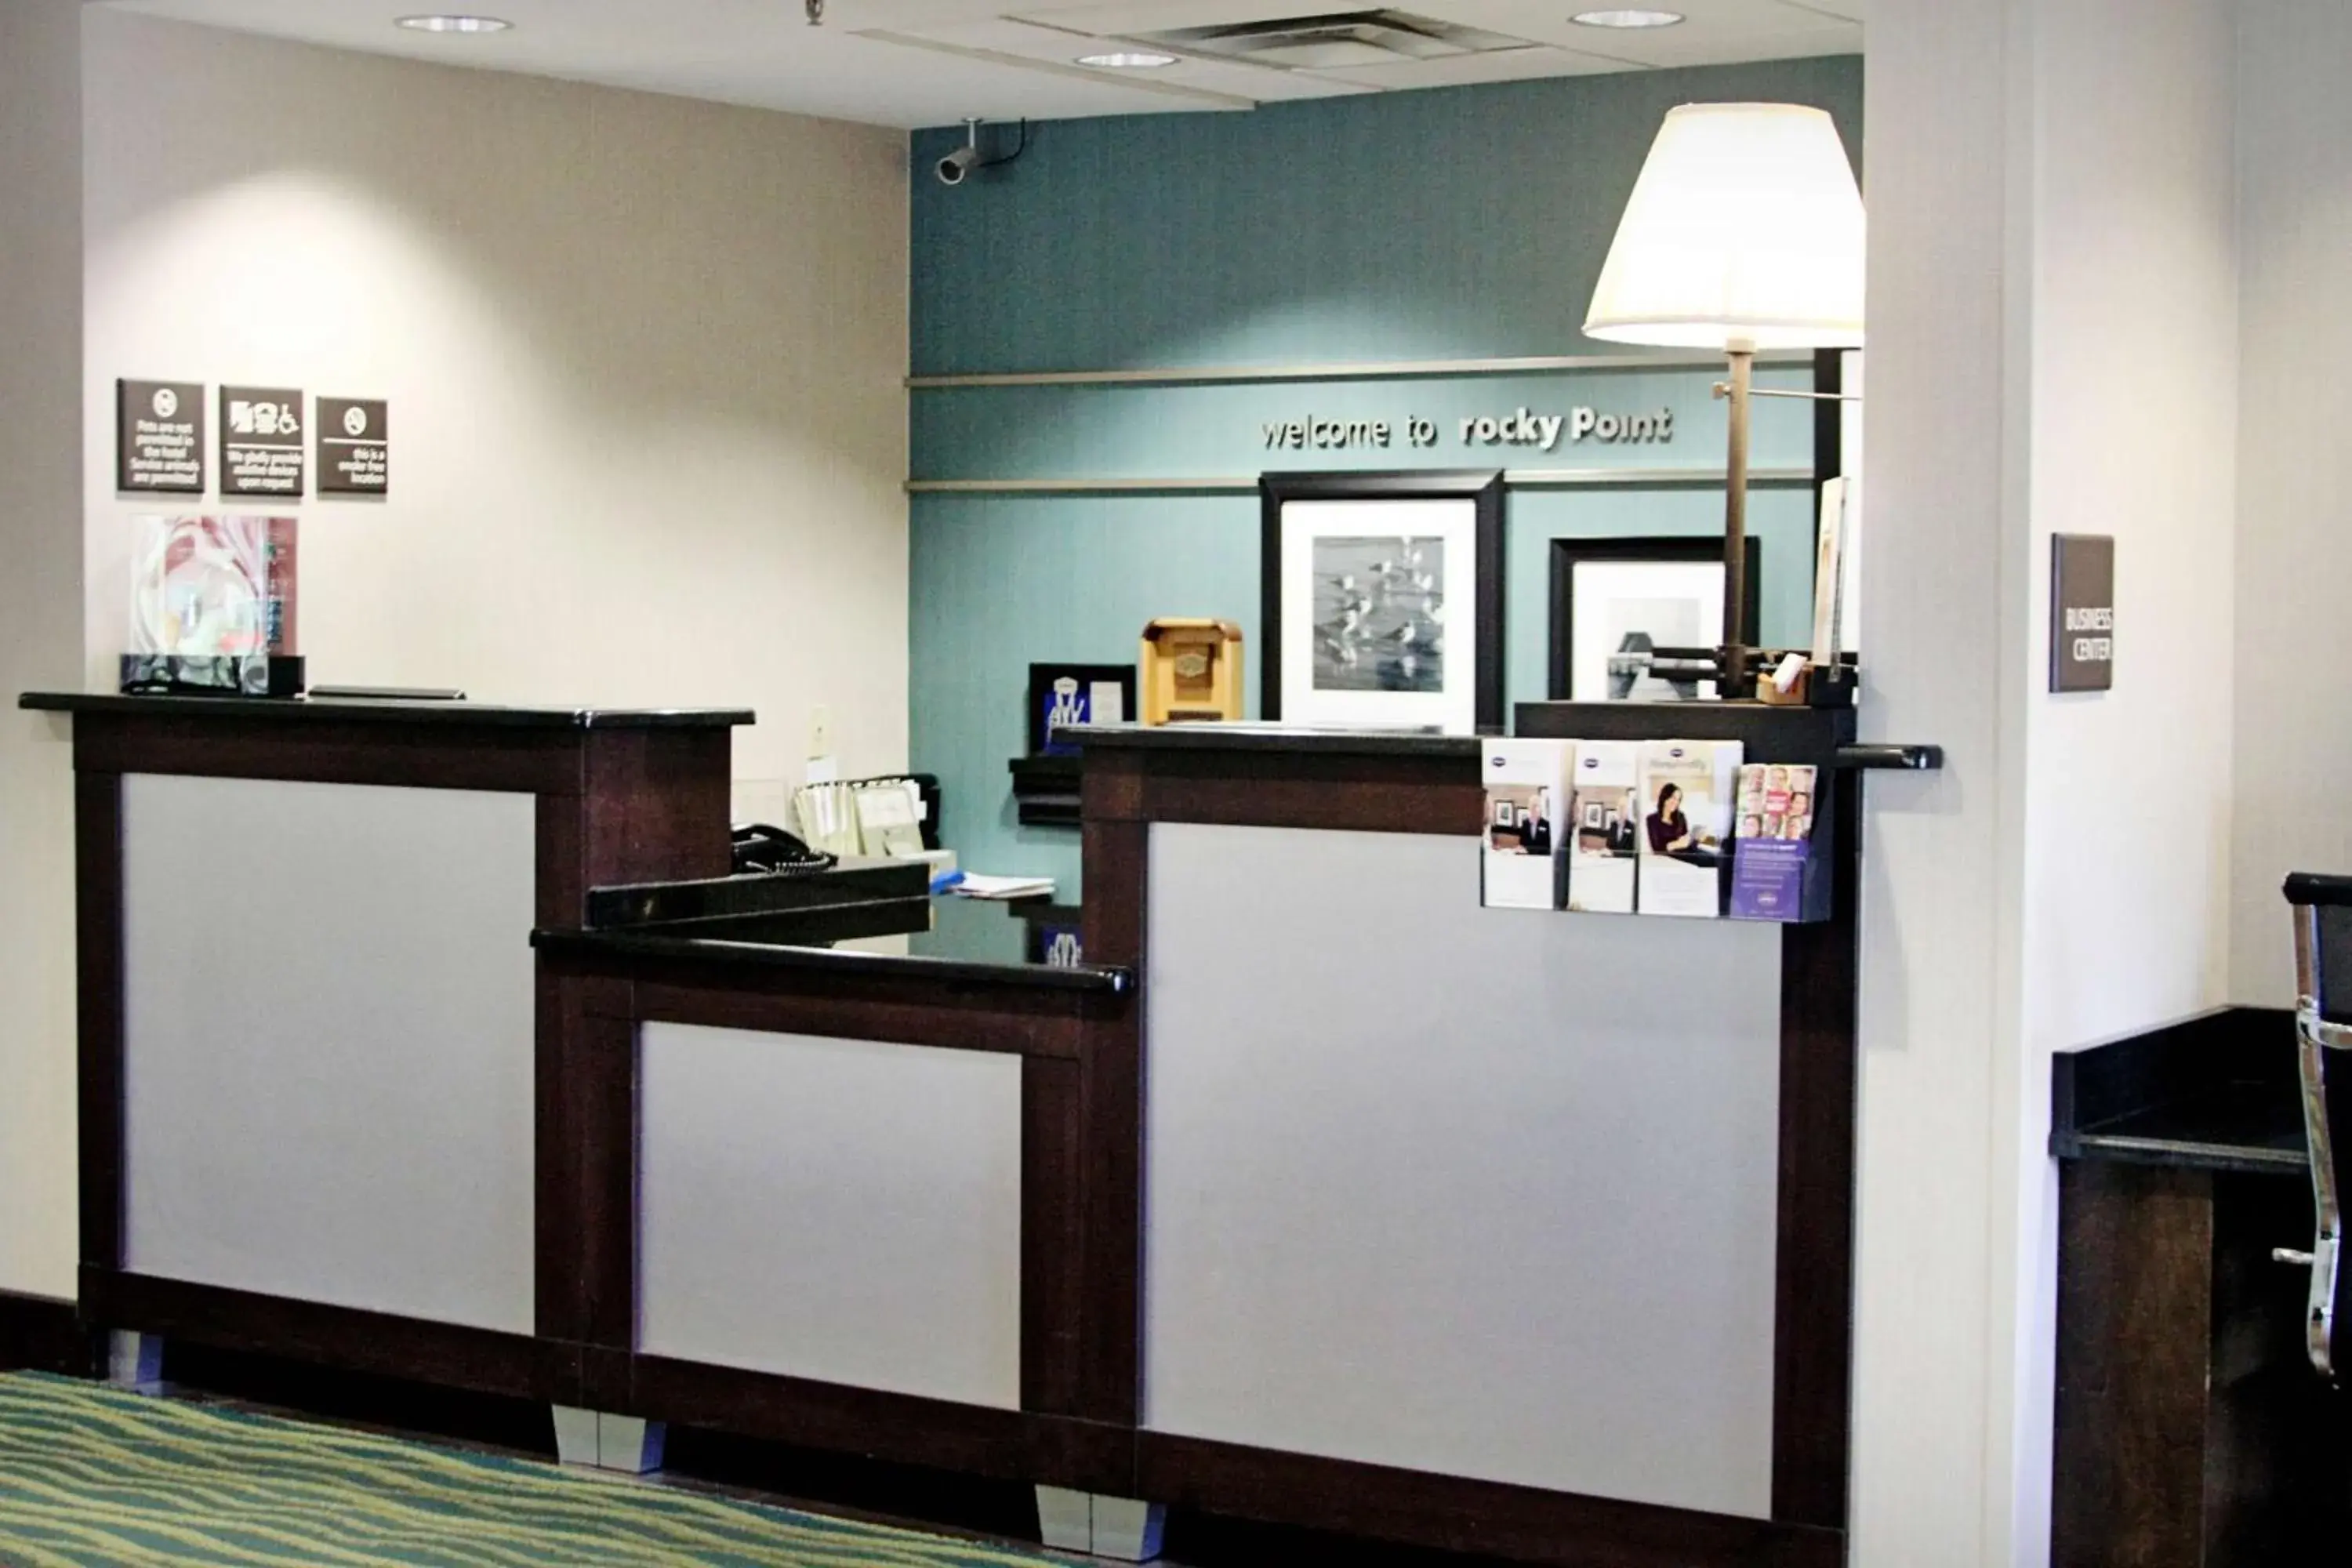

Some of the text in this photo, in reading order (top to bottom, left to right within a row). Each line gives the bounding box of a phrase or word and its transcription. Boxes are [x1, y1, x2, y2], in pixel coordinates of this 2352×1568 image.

[1262, 405, 1673, 451] welcome to rocky Point
